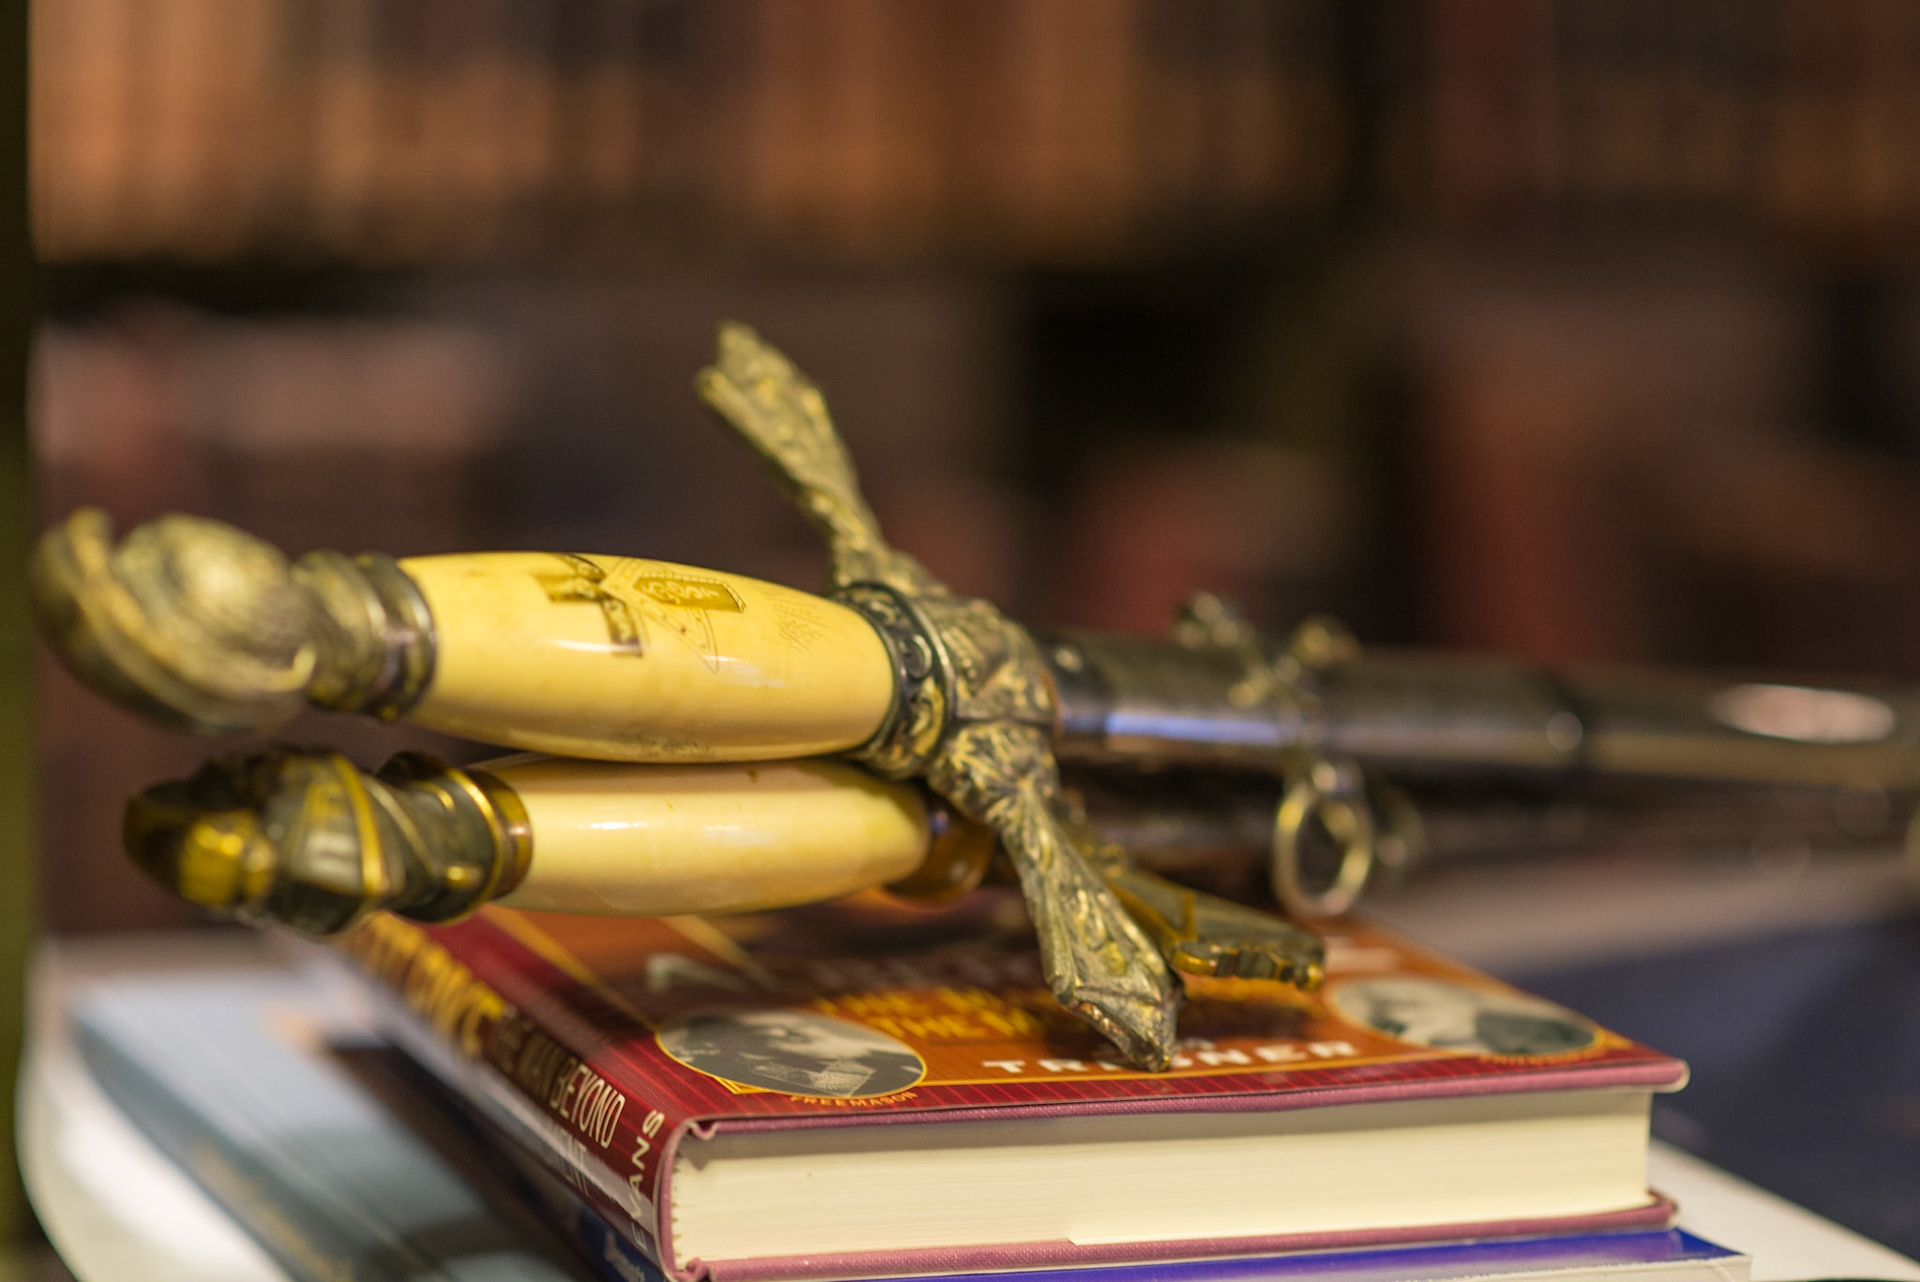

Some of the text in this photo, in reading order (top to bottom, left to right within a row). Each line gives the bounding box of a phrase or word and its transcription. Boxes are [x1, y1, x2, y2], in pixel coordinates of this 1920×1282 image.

[550, 1056, 626, 1149] BEYOND
[790, 1091, 918, 1107] FREEMASON
[629, 1109, 666, 1250] EVANS
